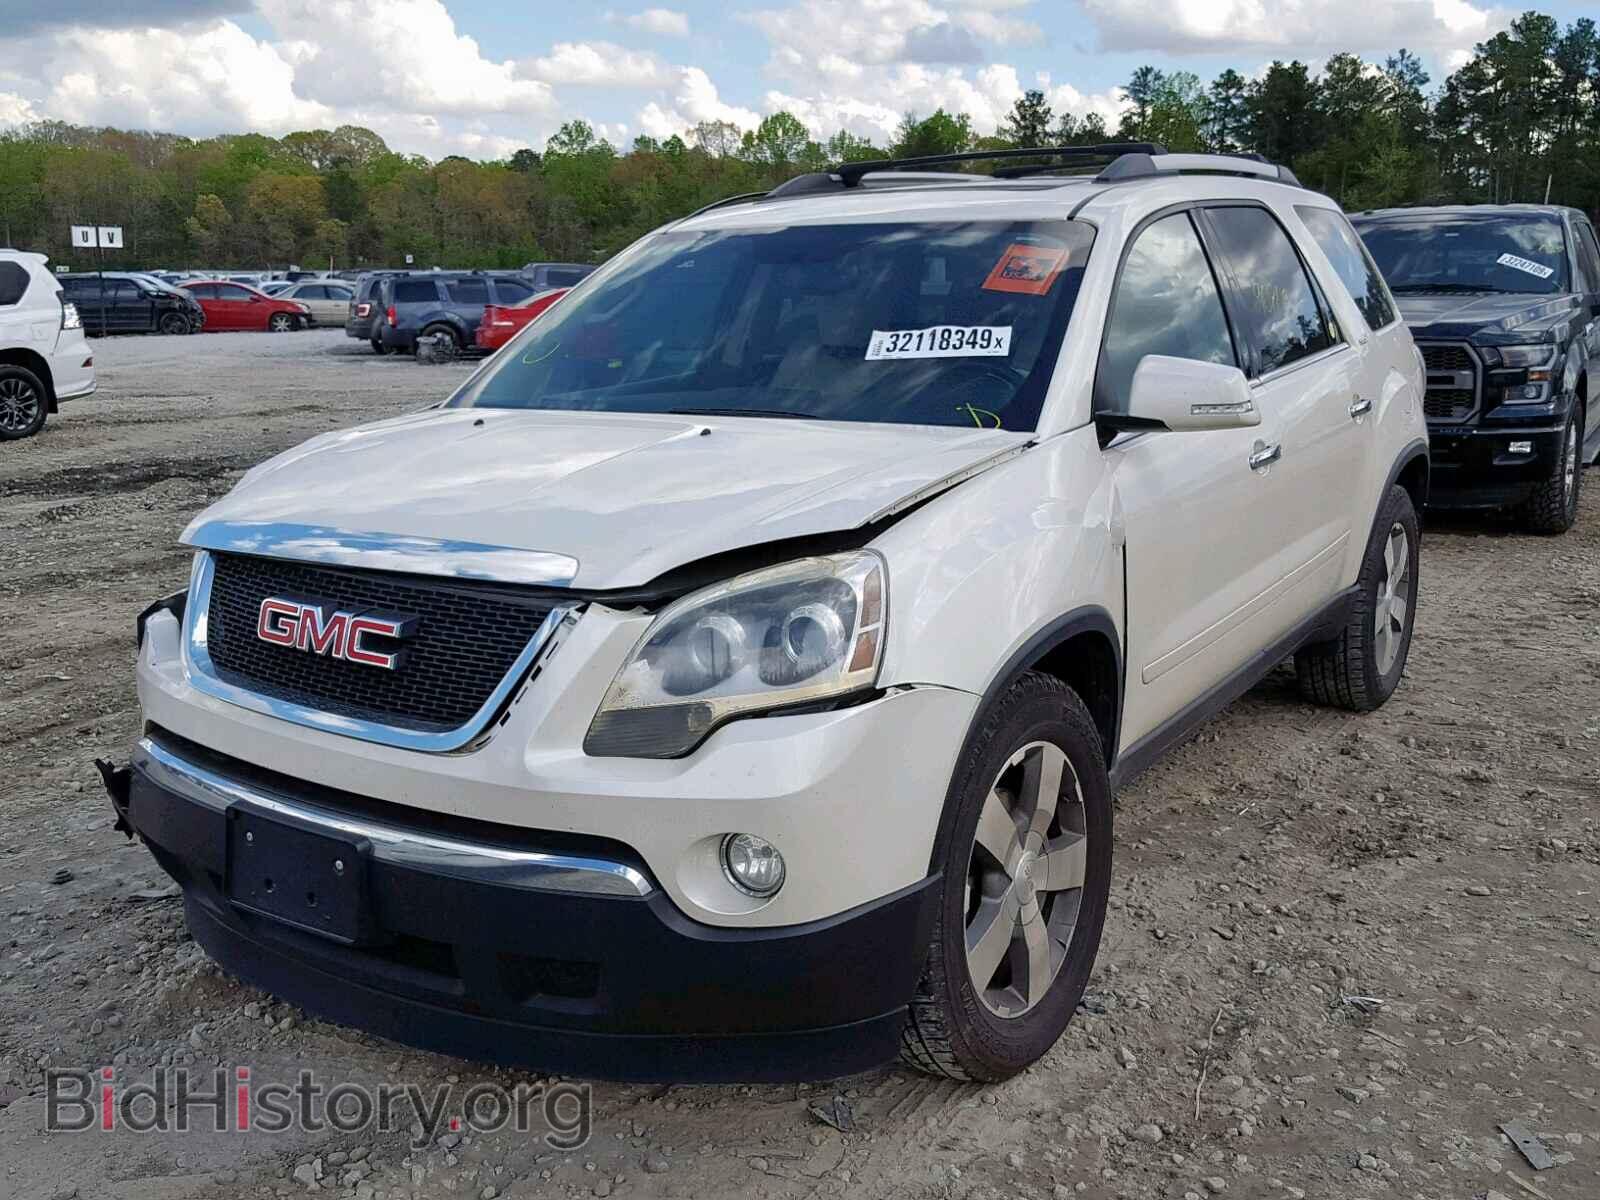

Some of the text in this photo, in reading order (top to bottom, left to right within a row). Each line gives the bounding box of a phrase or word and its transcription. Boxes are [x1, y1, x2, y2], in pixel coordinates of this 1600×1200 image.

[81, 230, 89, 243] U
[107, 231, 115, 244] V
[257, 598, 401, 670] GMC
